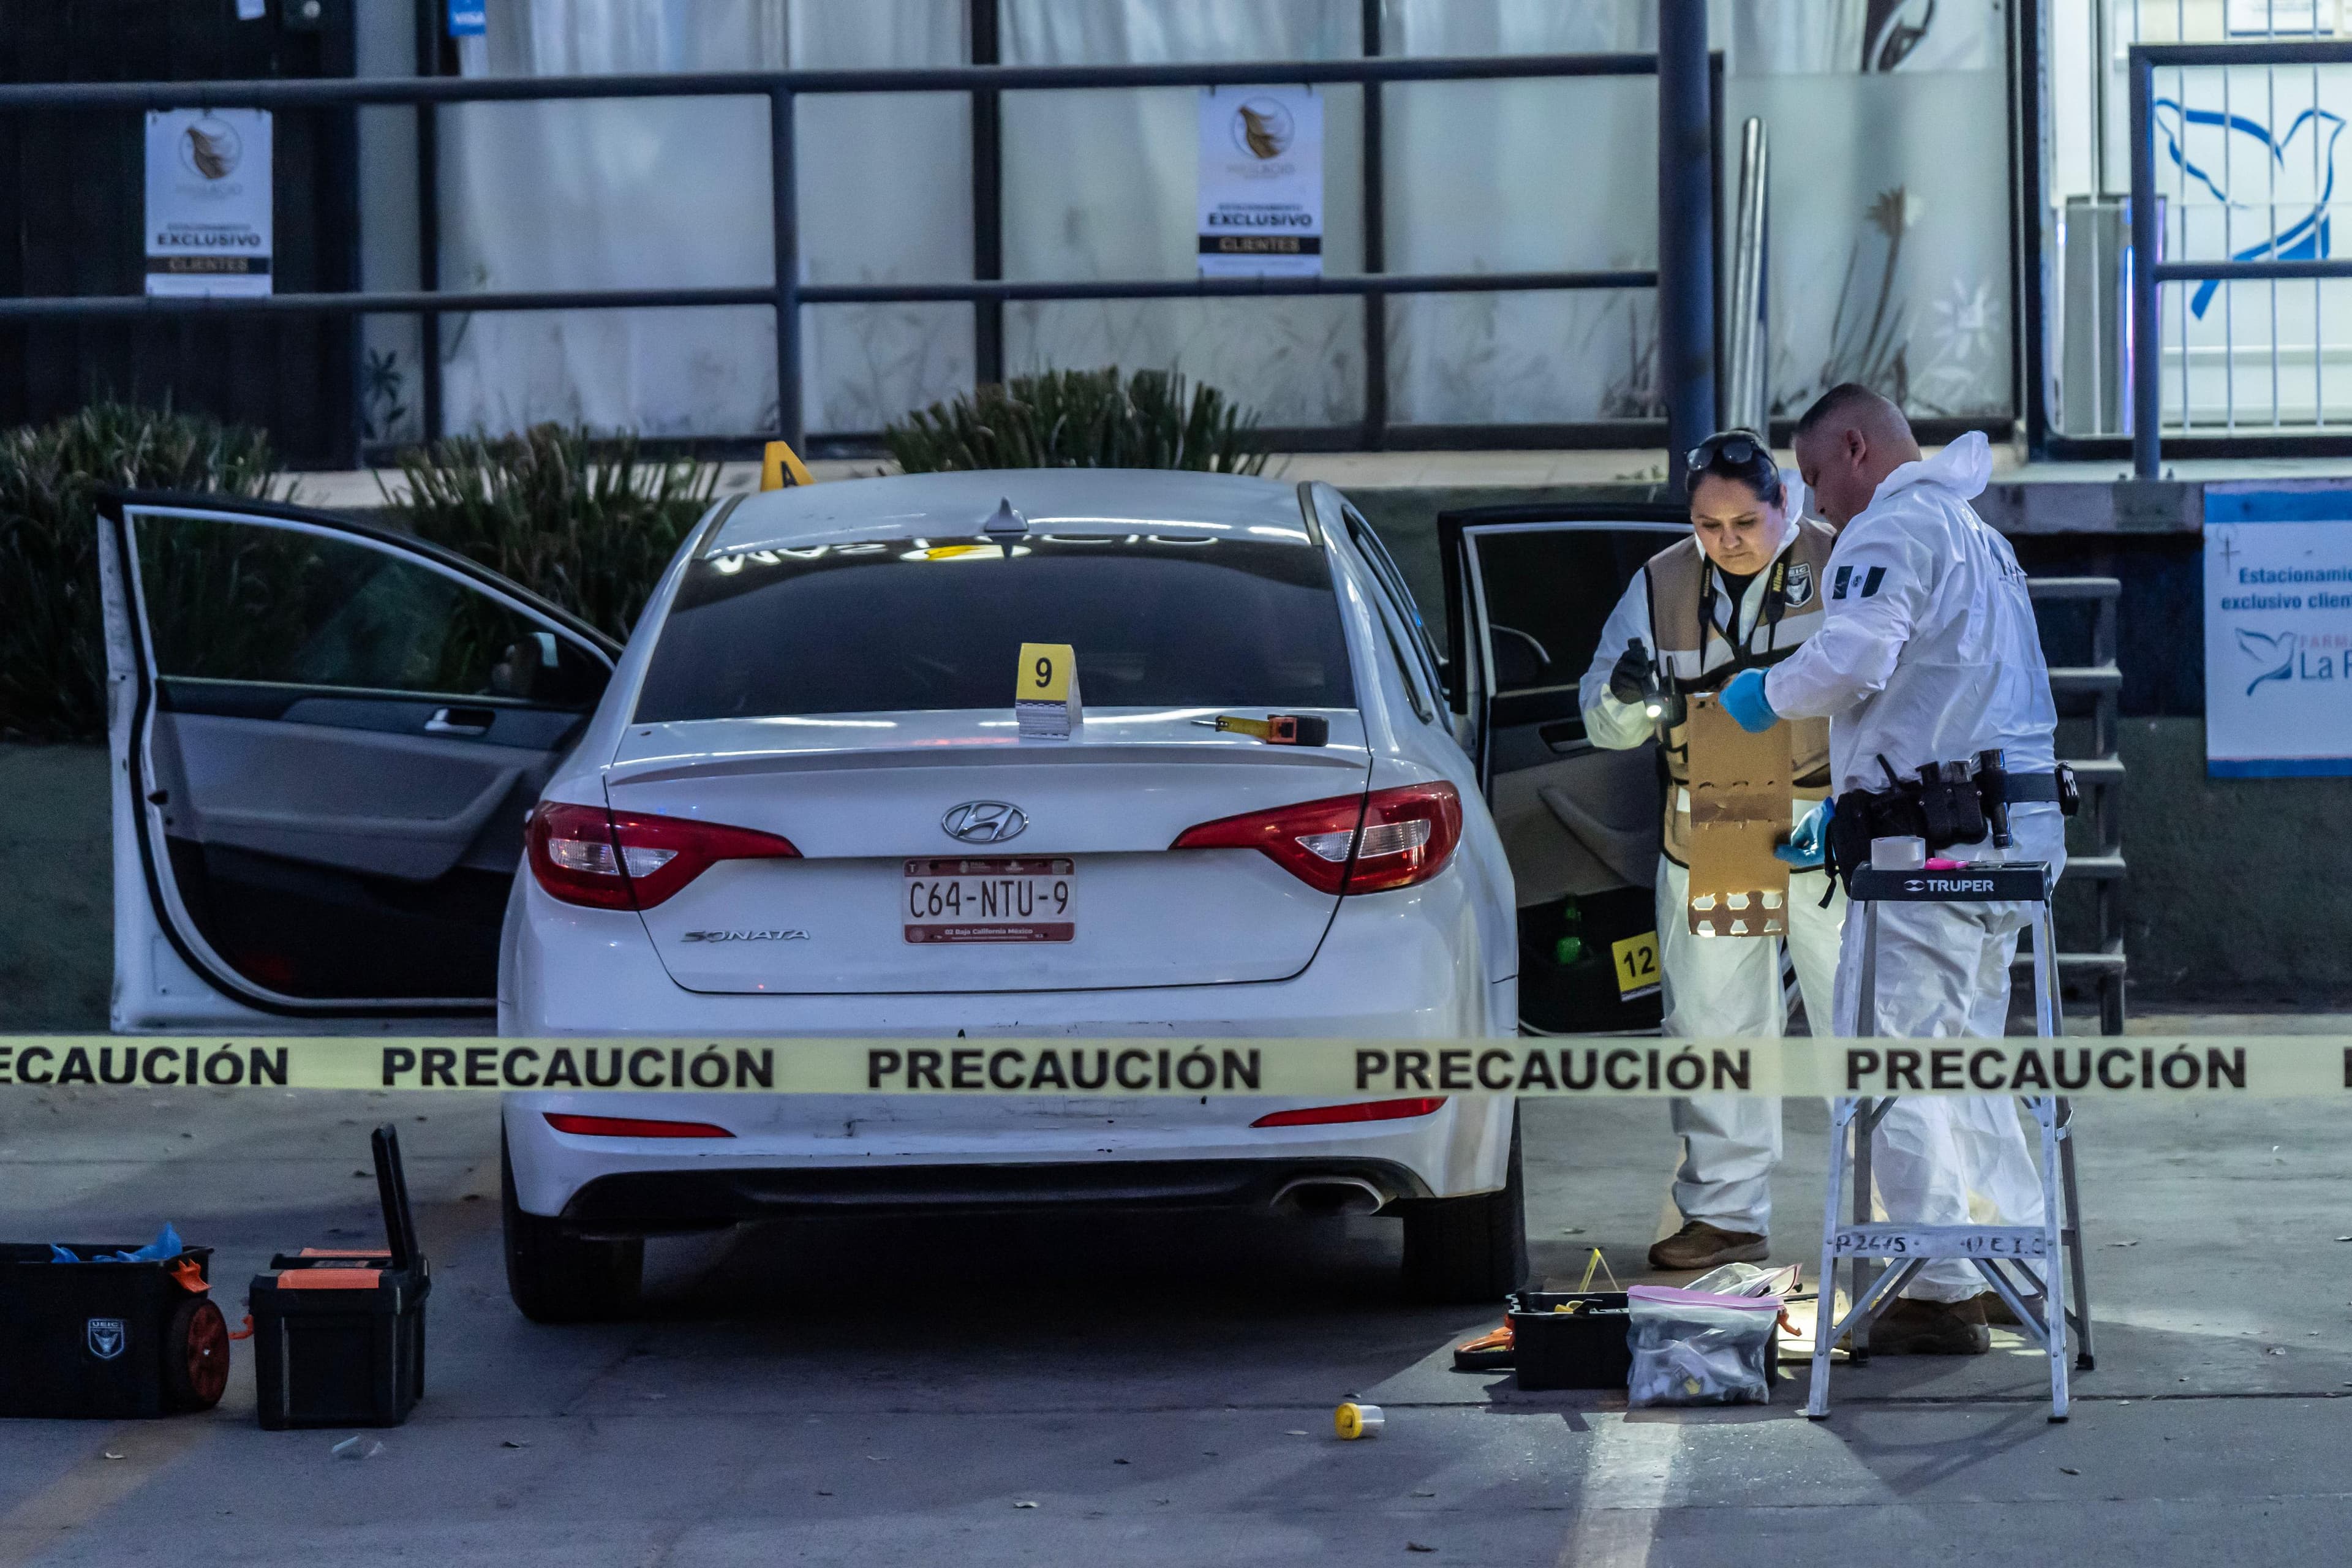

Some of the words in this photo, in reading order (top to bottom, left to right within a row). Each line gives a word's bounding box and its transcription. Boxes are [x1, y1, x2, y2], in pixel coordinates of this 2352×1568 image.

[1209, 213, 1313, 227] EXCLUSIVO
[157, 233, 261, 246] EXCLUSIVO
[780, 461, 799, 488] A
[1773, 562, 1784, 592] Nikon
[2221, 593, 2302, 609] exclusivo
[2308, 592, 2352, 608] clien
[2300, 634, 2352, 647] FARM
[1035, 657, 1052, 688] 9
[2301, 651, 2332, 679] La
[910, 880, 1069, 918] C64-NTU-9
[1927, 880, 1994, 892] TRUPER
[681, 930, 810, 943] SONATA
[1624, 946, 1656, 978] 12
[382, 1044, 774, 1087] PRECAUCIÓN
[868, 1044, 1261, 1089] PRECAUCIÓN
[1355, 1044, 1751, 1090] PRECAUCIÓN
[1846, 1044, 2246, 1090] PRECAUCIÓN
